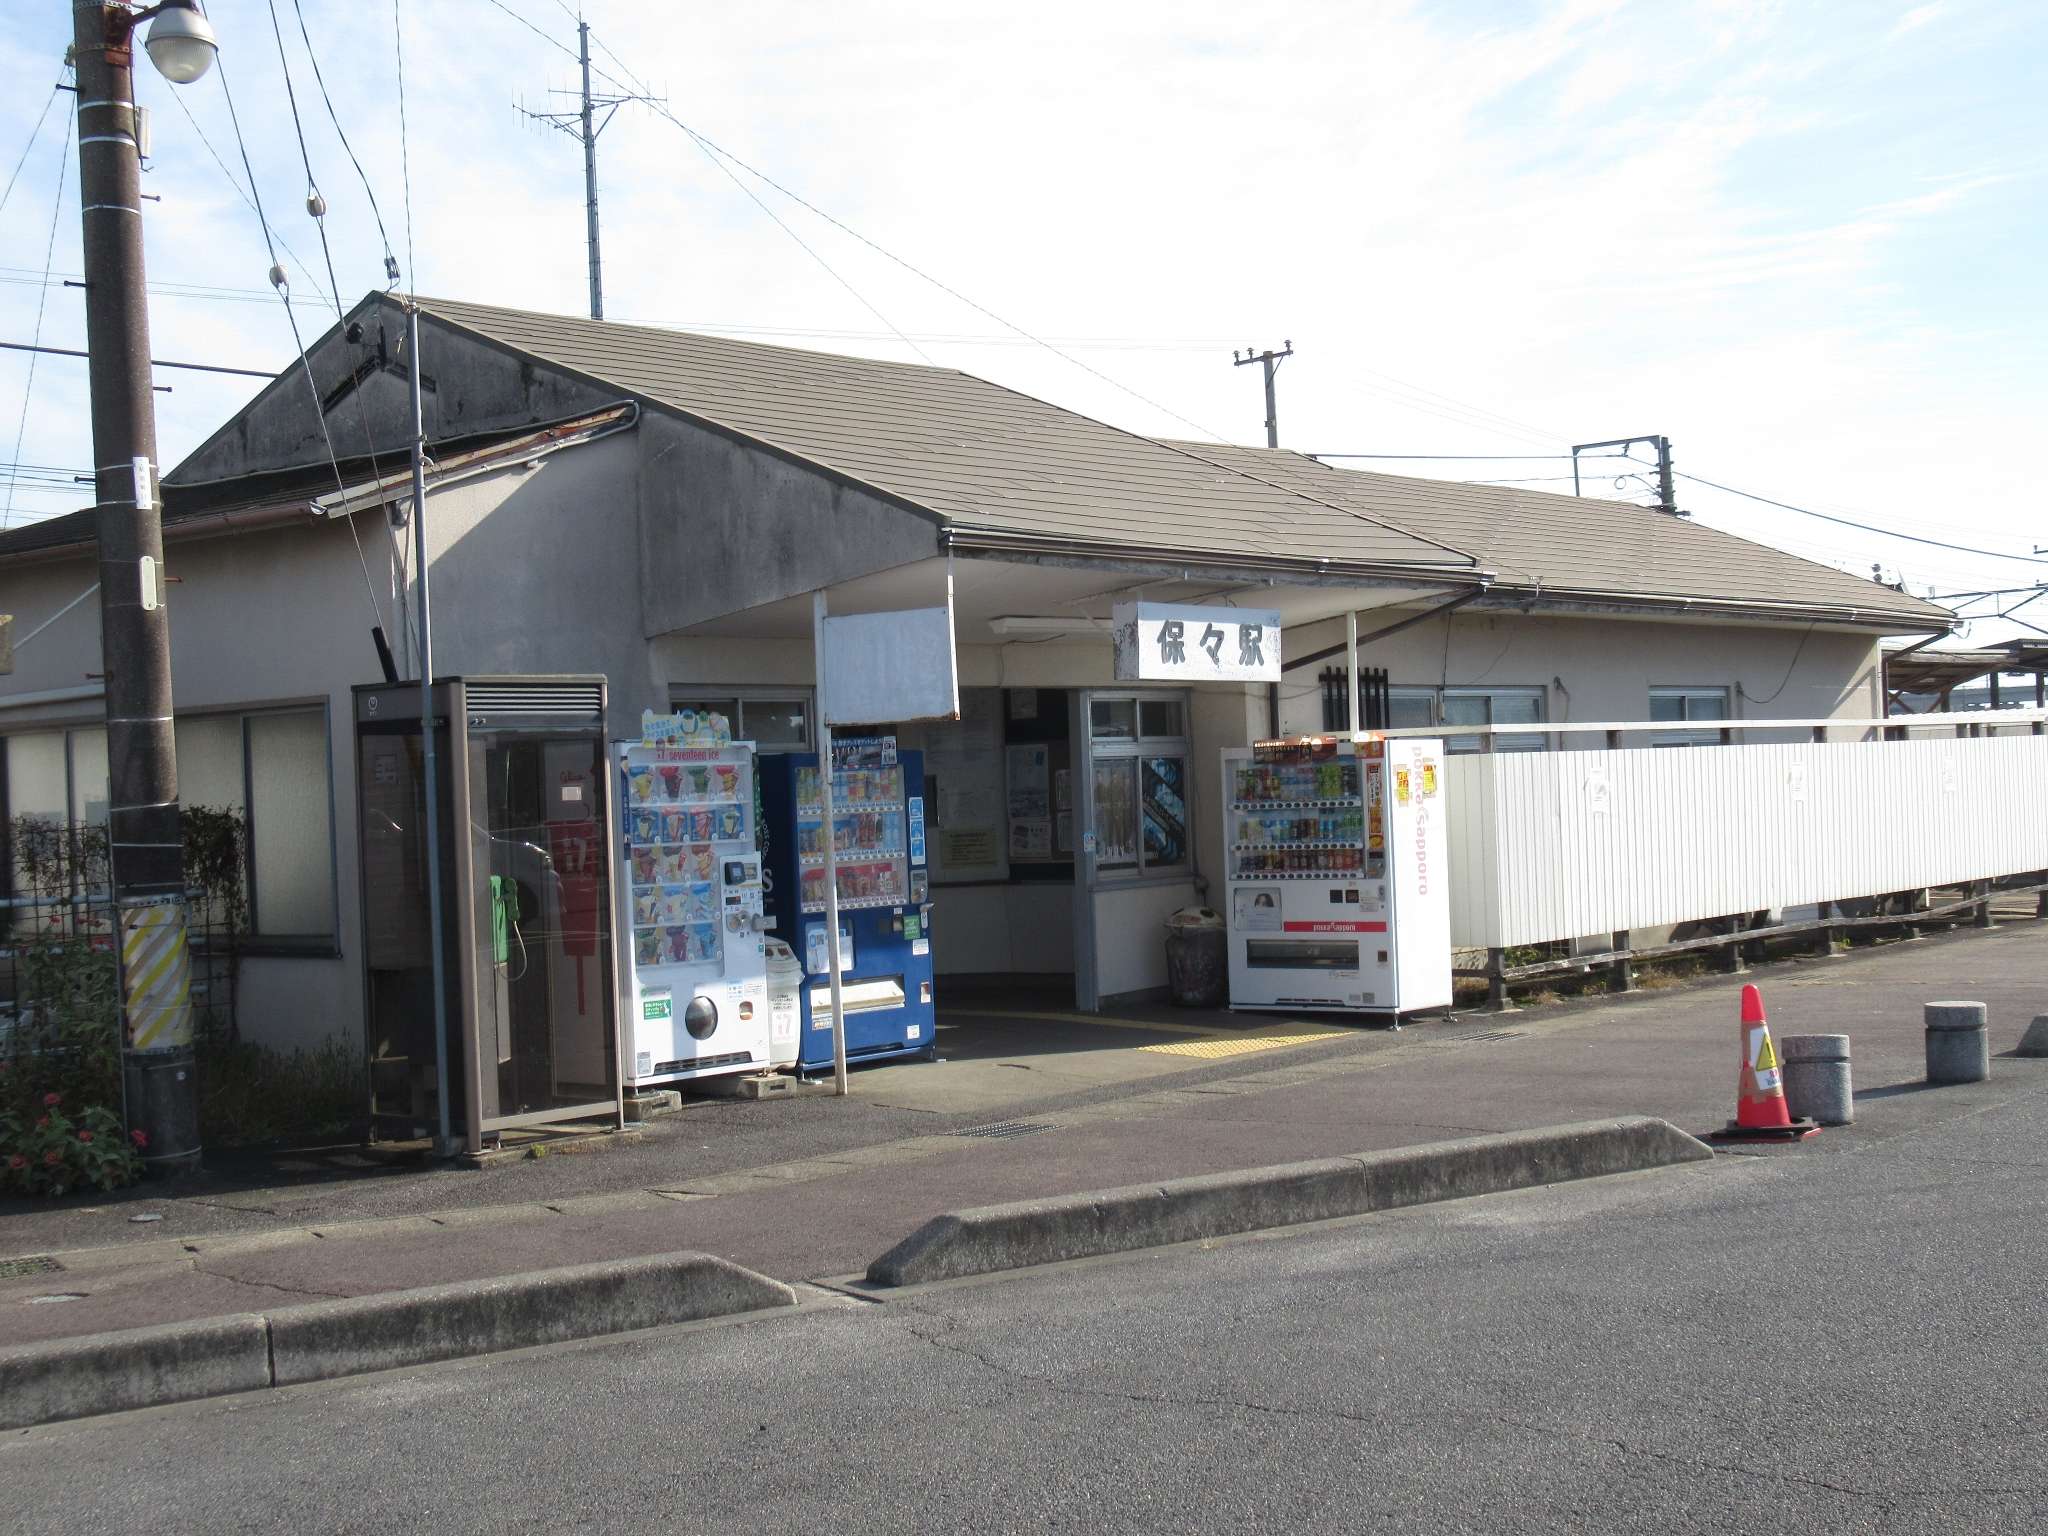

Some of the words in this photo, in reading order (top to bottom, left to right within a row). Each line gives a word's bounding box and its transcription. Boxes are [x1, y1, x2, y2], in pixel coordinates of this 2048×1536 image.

[1157, 620, 1265, 666] 保々駅
[670, 750, 707, 761] seventeen
[708, 750, 720, 760] ice
[1416, 814, 1428, 896] sapporo
